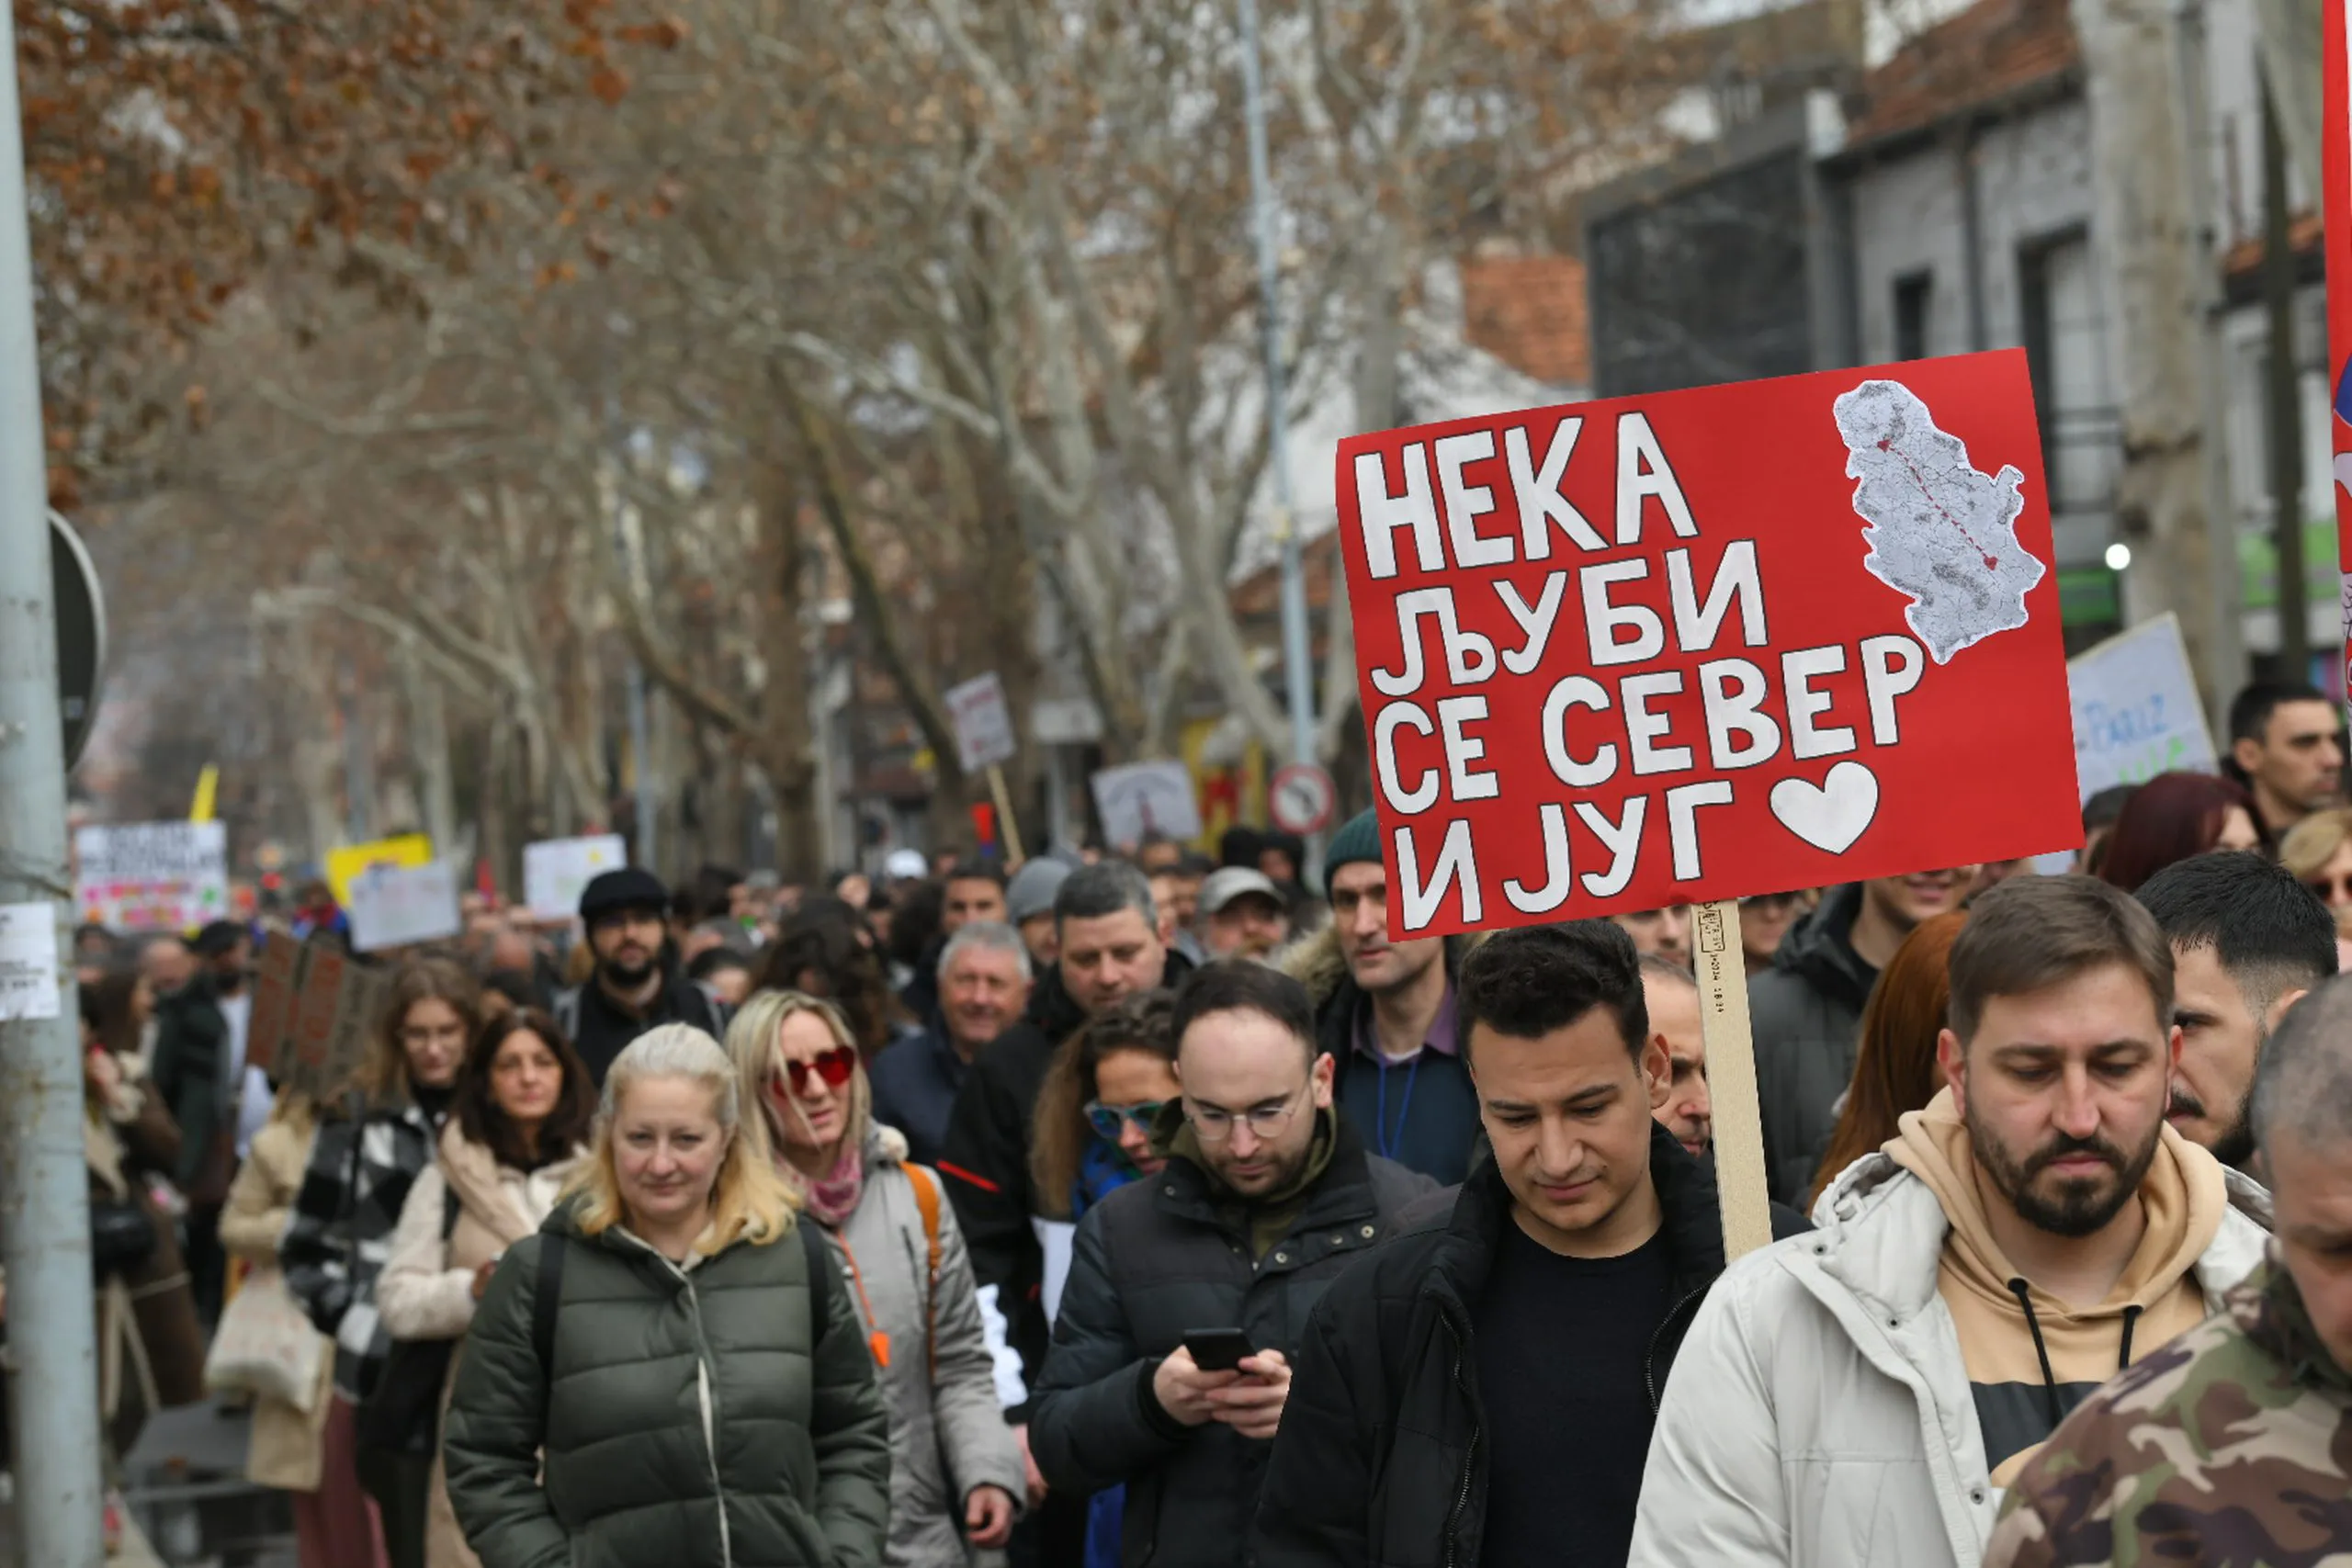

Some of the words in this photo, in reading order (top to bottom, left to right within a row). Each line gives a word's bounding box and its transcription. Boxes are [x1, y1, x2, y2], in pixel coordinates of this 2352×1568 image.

[1354, 411, 1700, 581] НЕКА
[1371, 538, 1770, 697] ЉУБИ
[1374, 694, 1499, 816] СЕ
[1541, 634, 1925, 789] СЕВЕР
[1394, 818, 1482, 931] И
